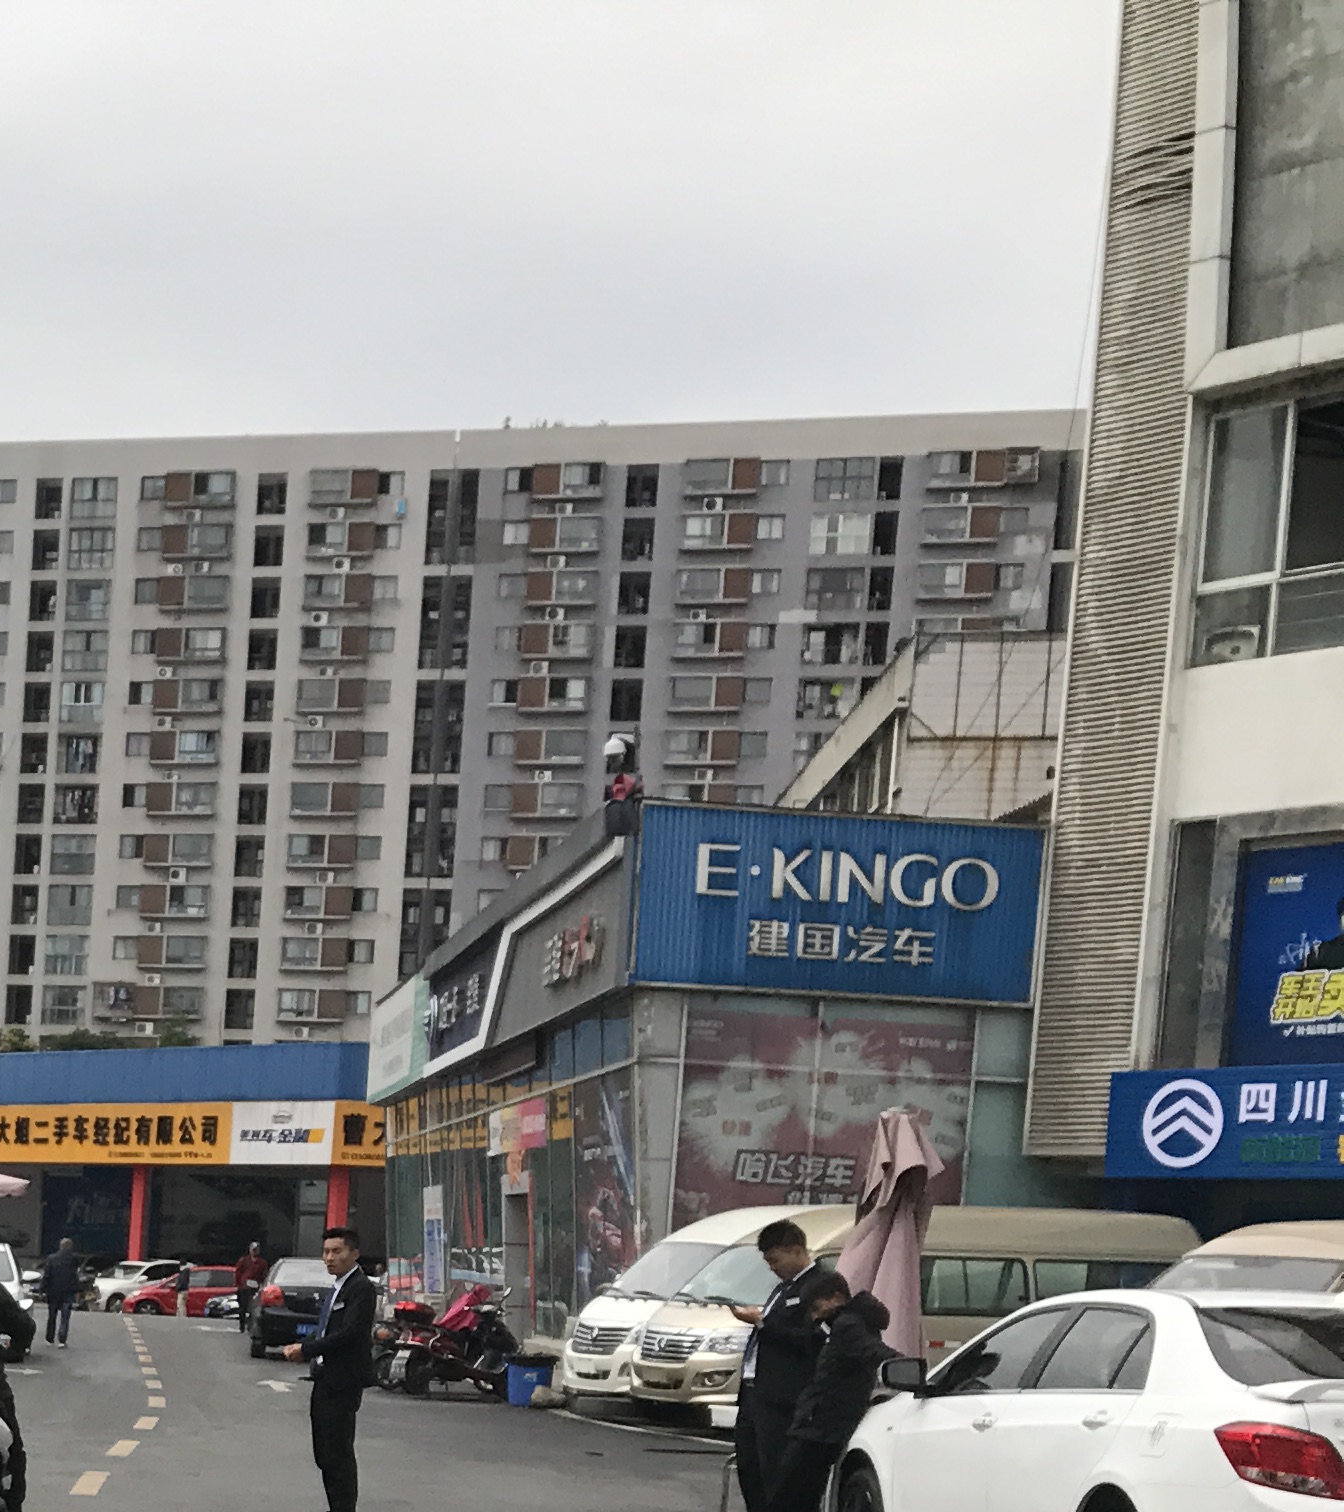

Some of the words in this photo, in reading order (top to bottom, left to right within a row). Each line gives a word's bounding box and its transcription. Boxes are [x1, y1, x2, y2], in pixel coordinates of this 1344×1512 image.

[747, 917, 937, 967] 建国汽车
[1238, 1079, 1344, 1124] 四川
[735, 1153, 856, 1187] 哈飞汽车
